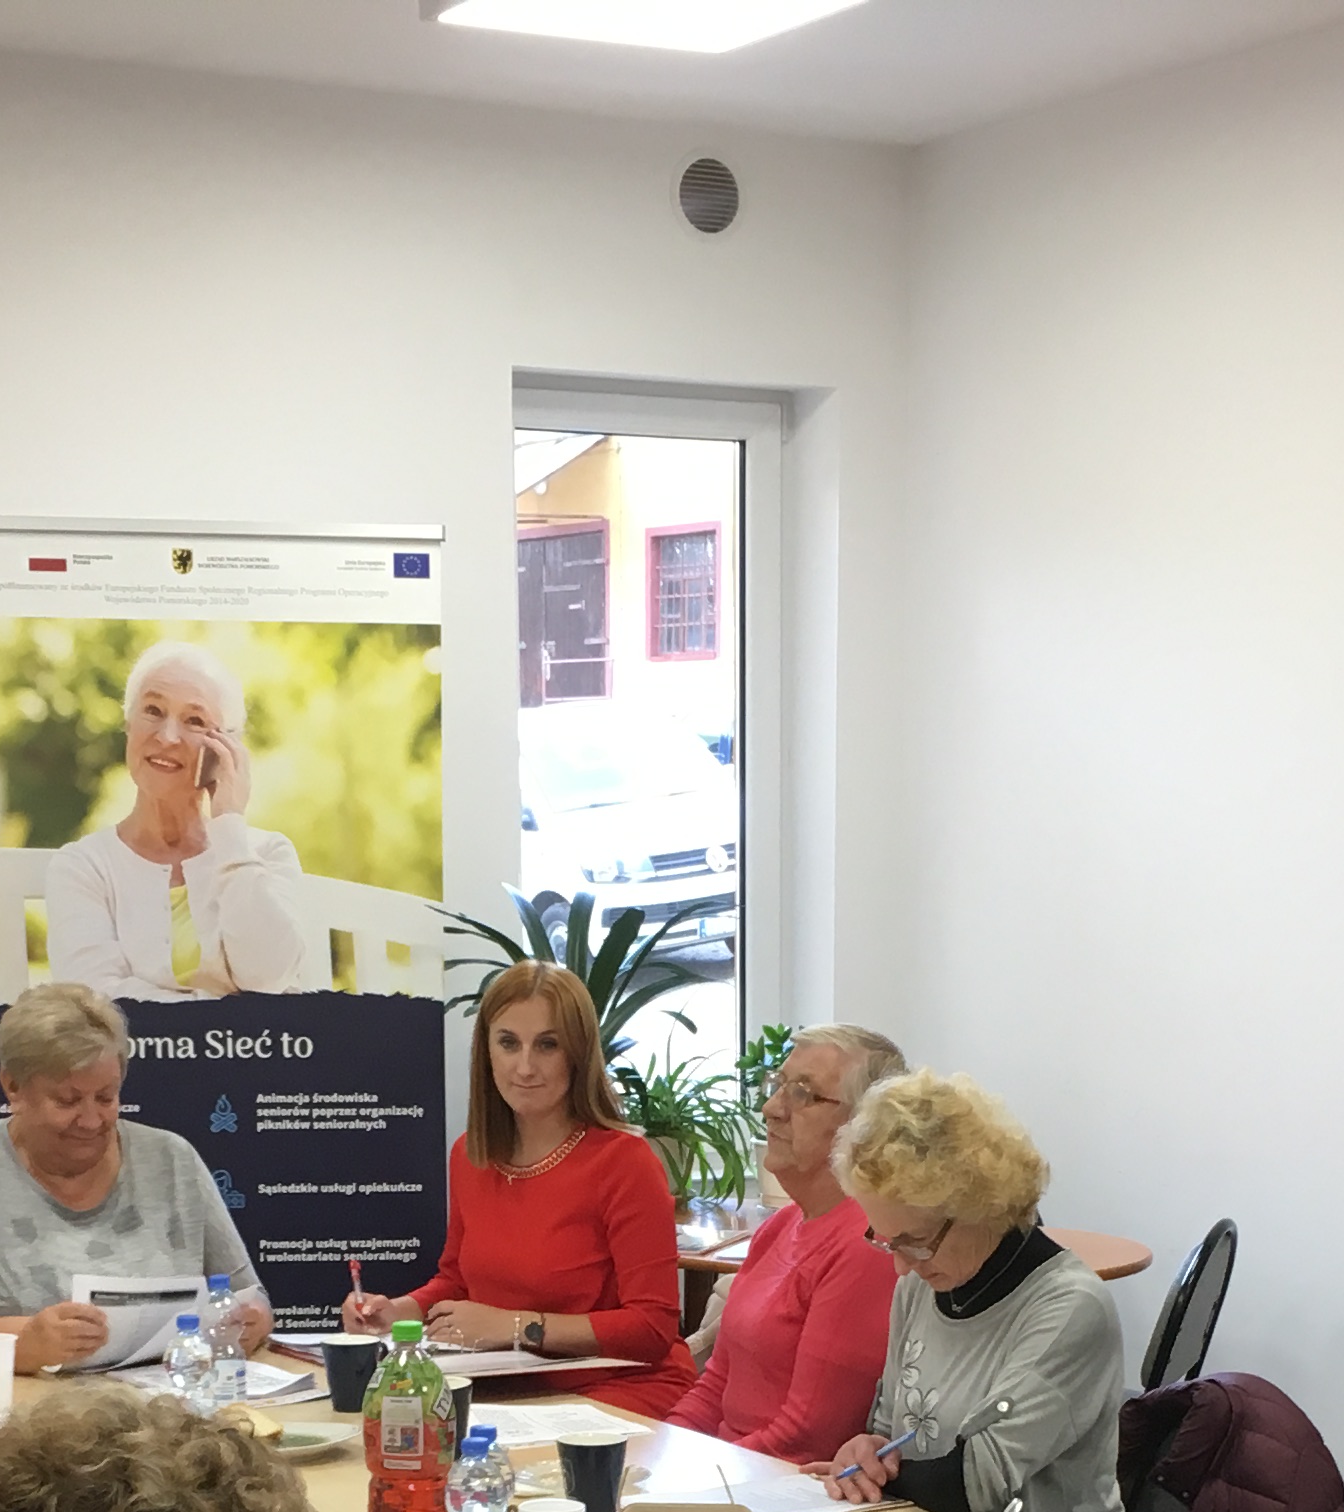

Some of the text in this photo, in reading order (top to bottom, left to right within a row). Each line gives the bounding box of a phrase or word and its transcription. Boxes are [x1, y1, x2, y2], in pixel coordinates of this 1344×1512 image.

[204, 1029, 273, 1060] Sieć
[281, 1031, 314, 1060] to
[256, 1092, 379, 1105] Animacja środowiska
[256, 1105, 424, 1118] seniorów poprzez organizację
[256, 1119, 387, 1132] pikników senioralnych
[258, 1182, 423, 1196] Sąsiedzkie usługi opiekuńcze
[259, 1237, 420, 1251] Promocja usług wzajemnych
[266, 1252, 342, 1262] wolontariatu
[343, 1251, 417, 1263] senioralnego
[285, 1318, 340, 1329] Seniorów
